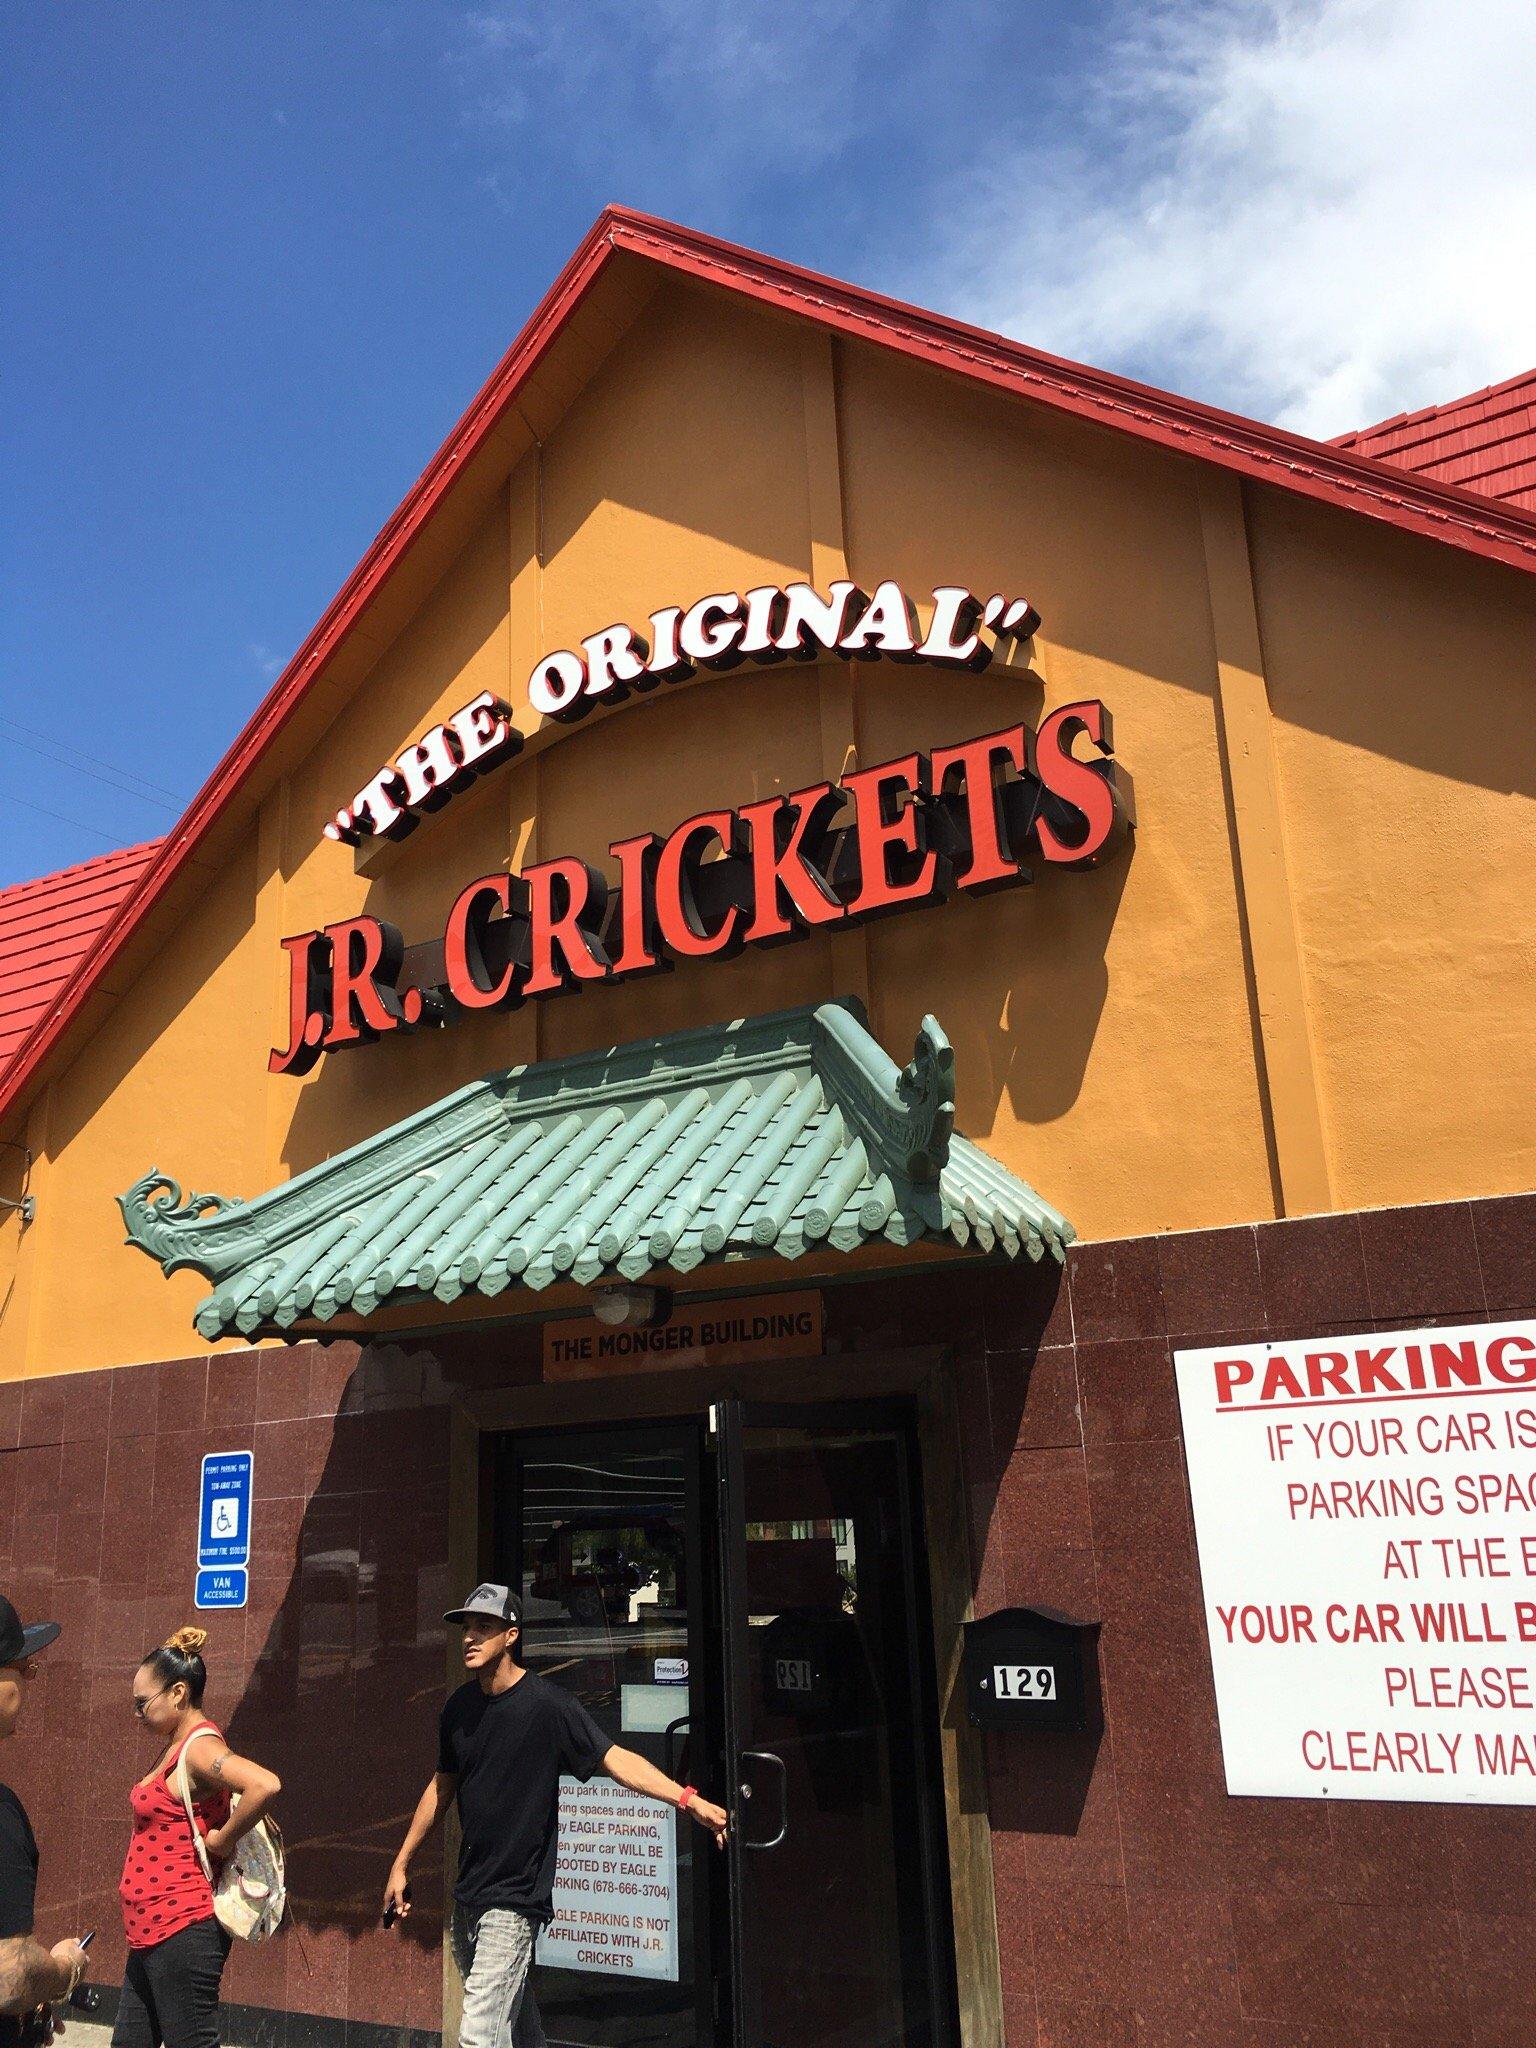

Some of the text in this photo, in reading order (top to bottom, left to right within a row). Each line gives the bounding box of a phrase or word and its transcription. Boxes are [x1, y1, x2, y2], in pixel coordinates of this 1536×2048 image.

[268, 699, 1116, 1074] J.R. CRICKETS
[552, 1312, 813, 1362] THE MONGER BUILDING
[1214, 1337, 1536, 1403] PARKING
[1266, 1409, 1536, 1461] IF YOUR CAR IS
[1287, 1478, 1444, 1520] PARKING
[1383, 1540, 1422, 1579] AT
[1431, 1537, 1511, 1578] THE
[204, 1590, 239, 1599] ACCESSIBLE
[213, 1577, 231, 1589] VAN
[1216, 1604, 1317, 1644] YOUR
[1326, 1604, 1405, 1643] CAR
[1410, 1603, 1507, 1642] WILL
[1000, 1668, 1052, 1697] 129
[1385, 1666, 1533, 1709] PLEASE
[1302, 1730, 1536, 1776] CLEARLY MA
[577, 1785, 598, 1798] park
[601, 1787, 609, 1797] in
[558, 1802, 669, 1819] king spaces and do not
[558, 1821, 661, 1840] ay EAGLE PARKING,
[557, 1842, 663, 1858] en your car WILL BE
[555, 1858, 657, 1877] BOOTED BY EAGLE
[554, 1877, 670, 1901] RKING (678-666-3704)
[555, 1909, 670, 1931] GLE PARKING IS NOT
[548, 1928, 664, 1951] AFFILIATED WITH J.R.
[577, 1950, 634, 1968] CRICKETS
